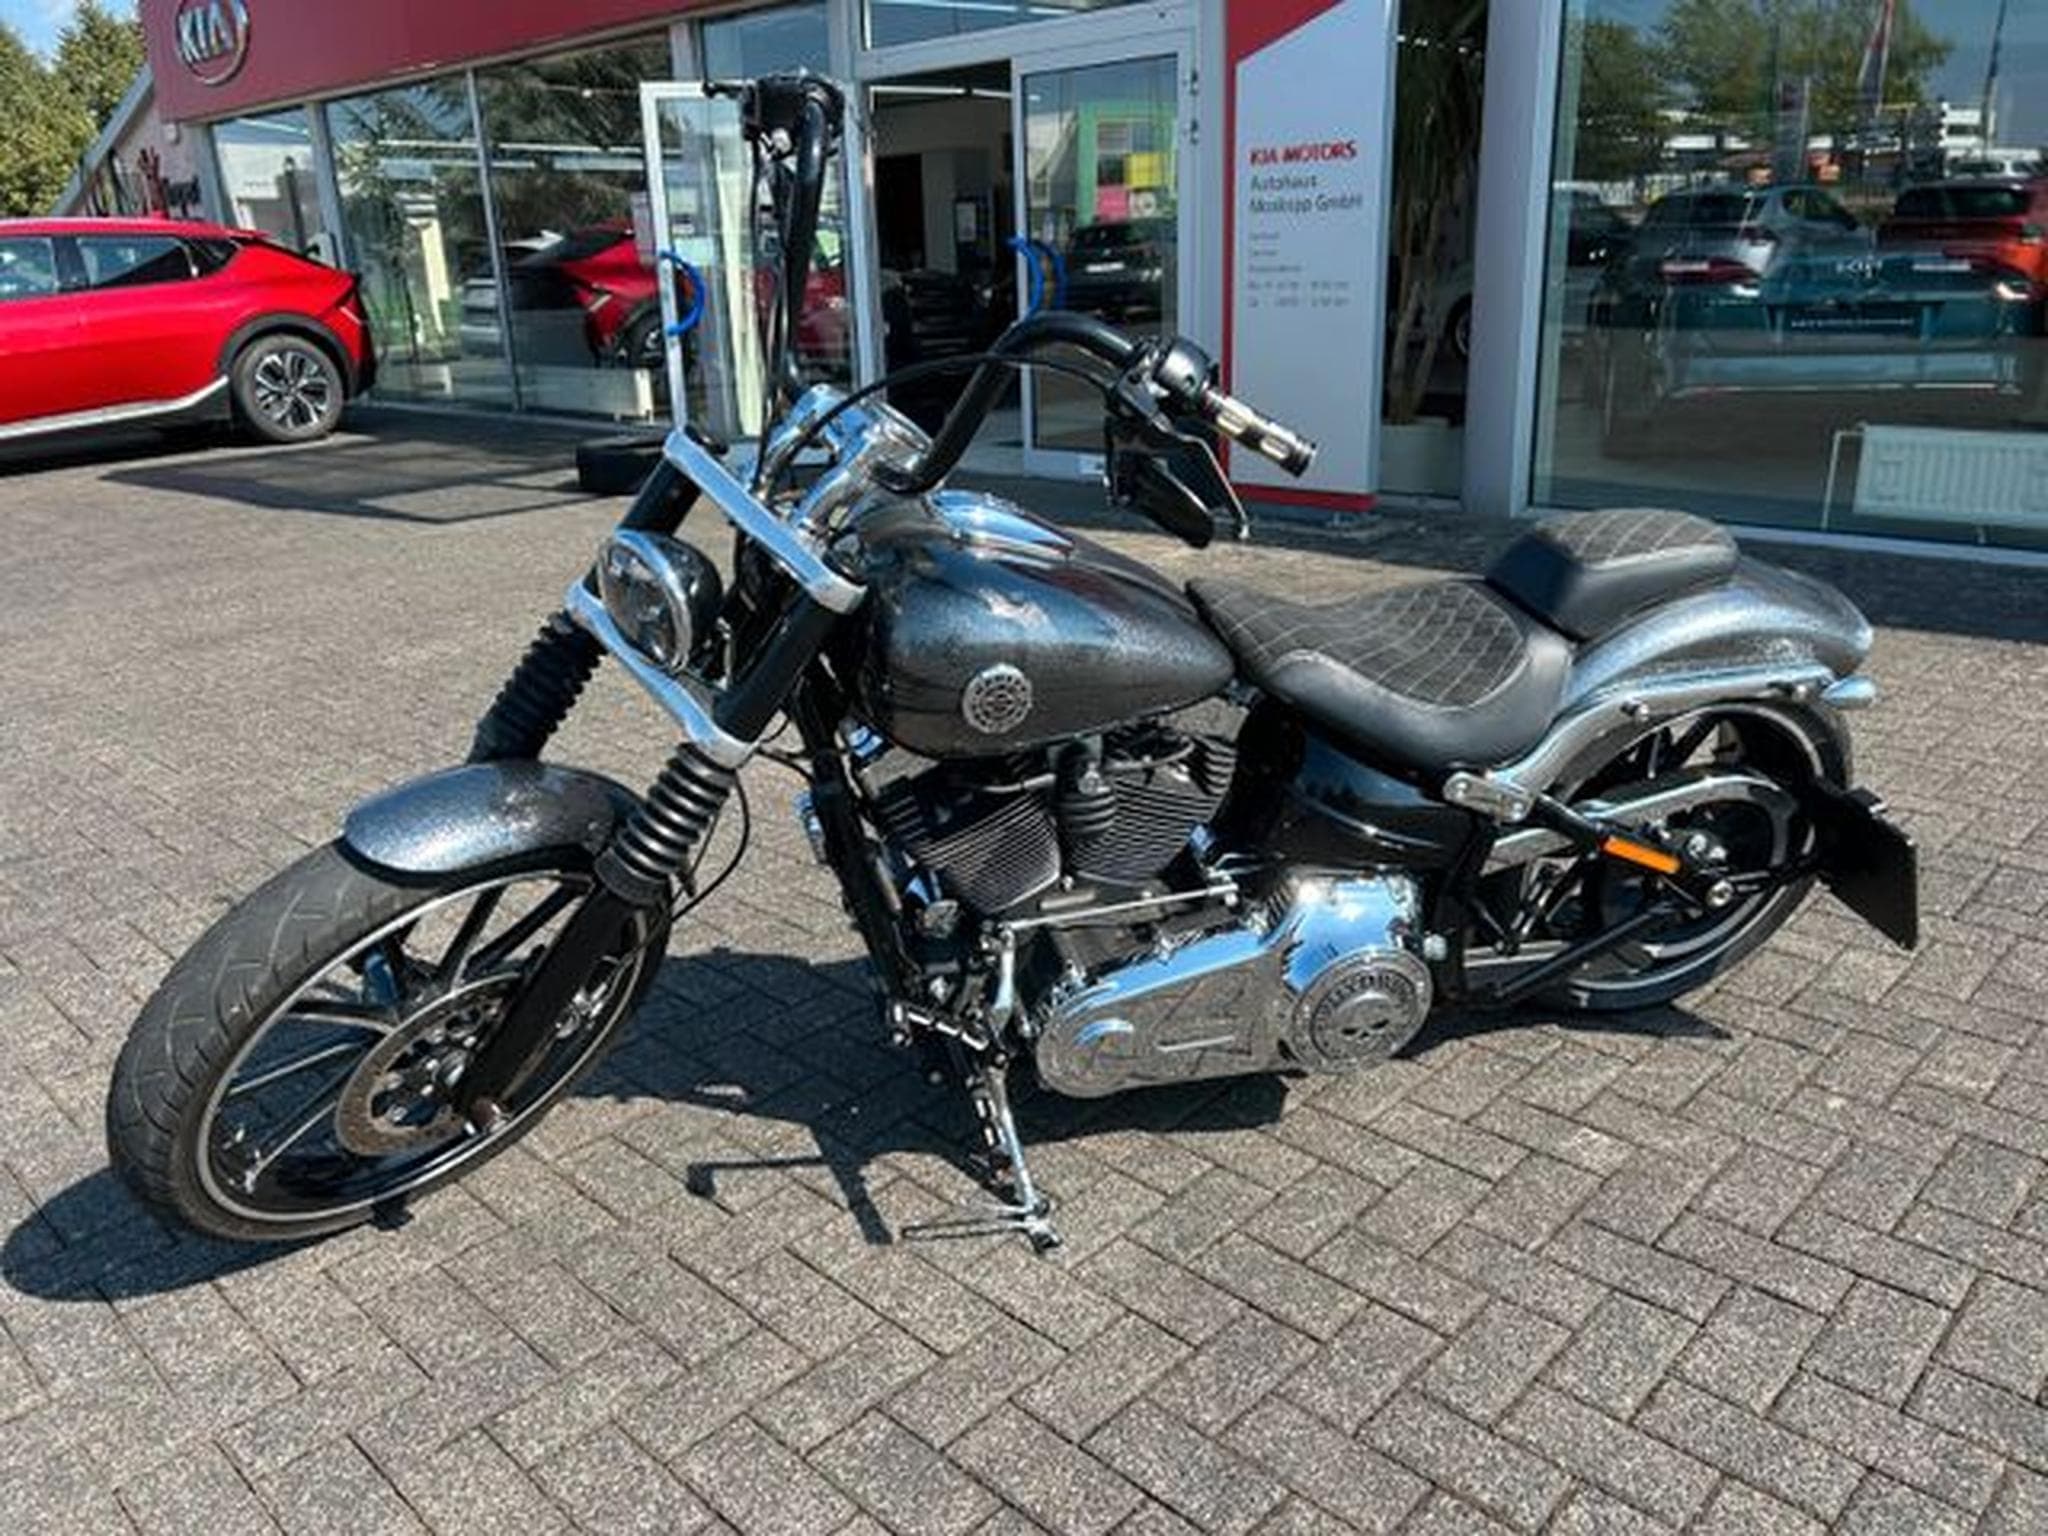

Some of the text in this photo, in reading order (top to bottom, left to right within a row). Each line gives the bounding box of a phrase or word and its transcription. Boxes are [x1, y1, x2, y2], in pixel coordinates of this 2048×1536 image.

[181, 3, 233, 62] KIA
[1250, 140, 1358, 165] KIA MOTORS
